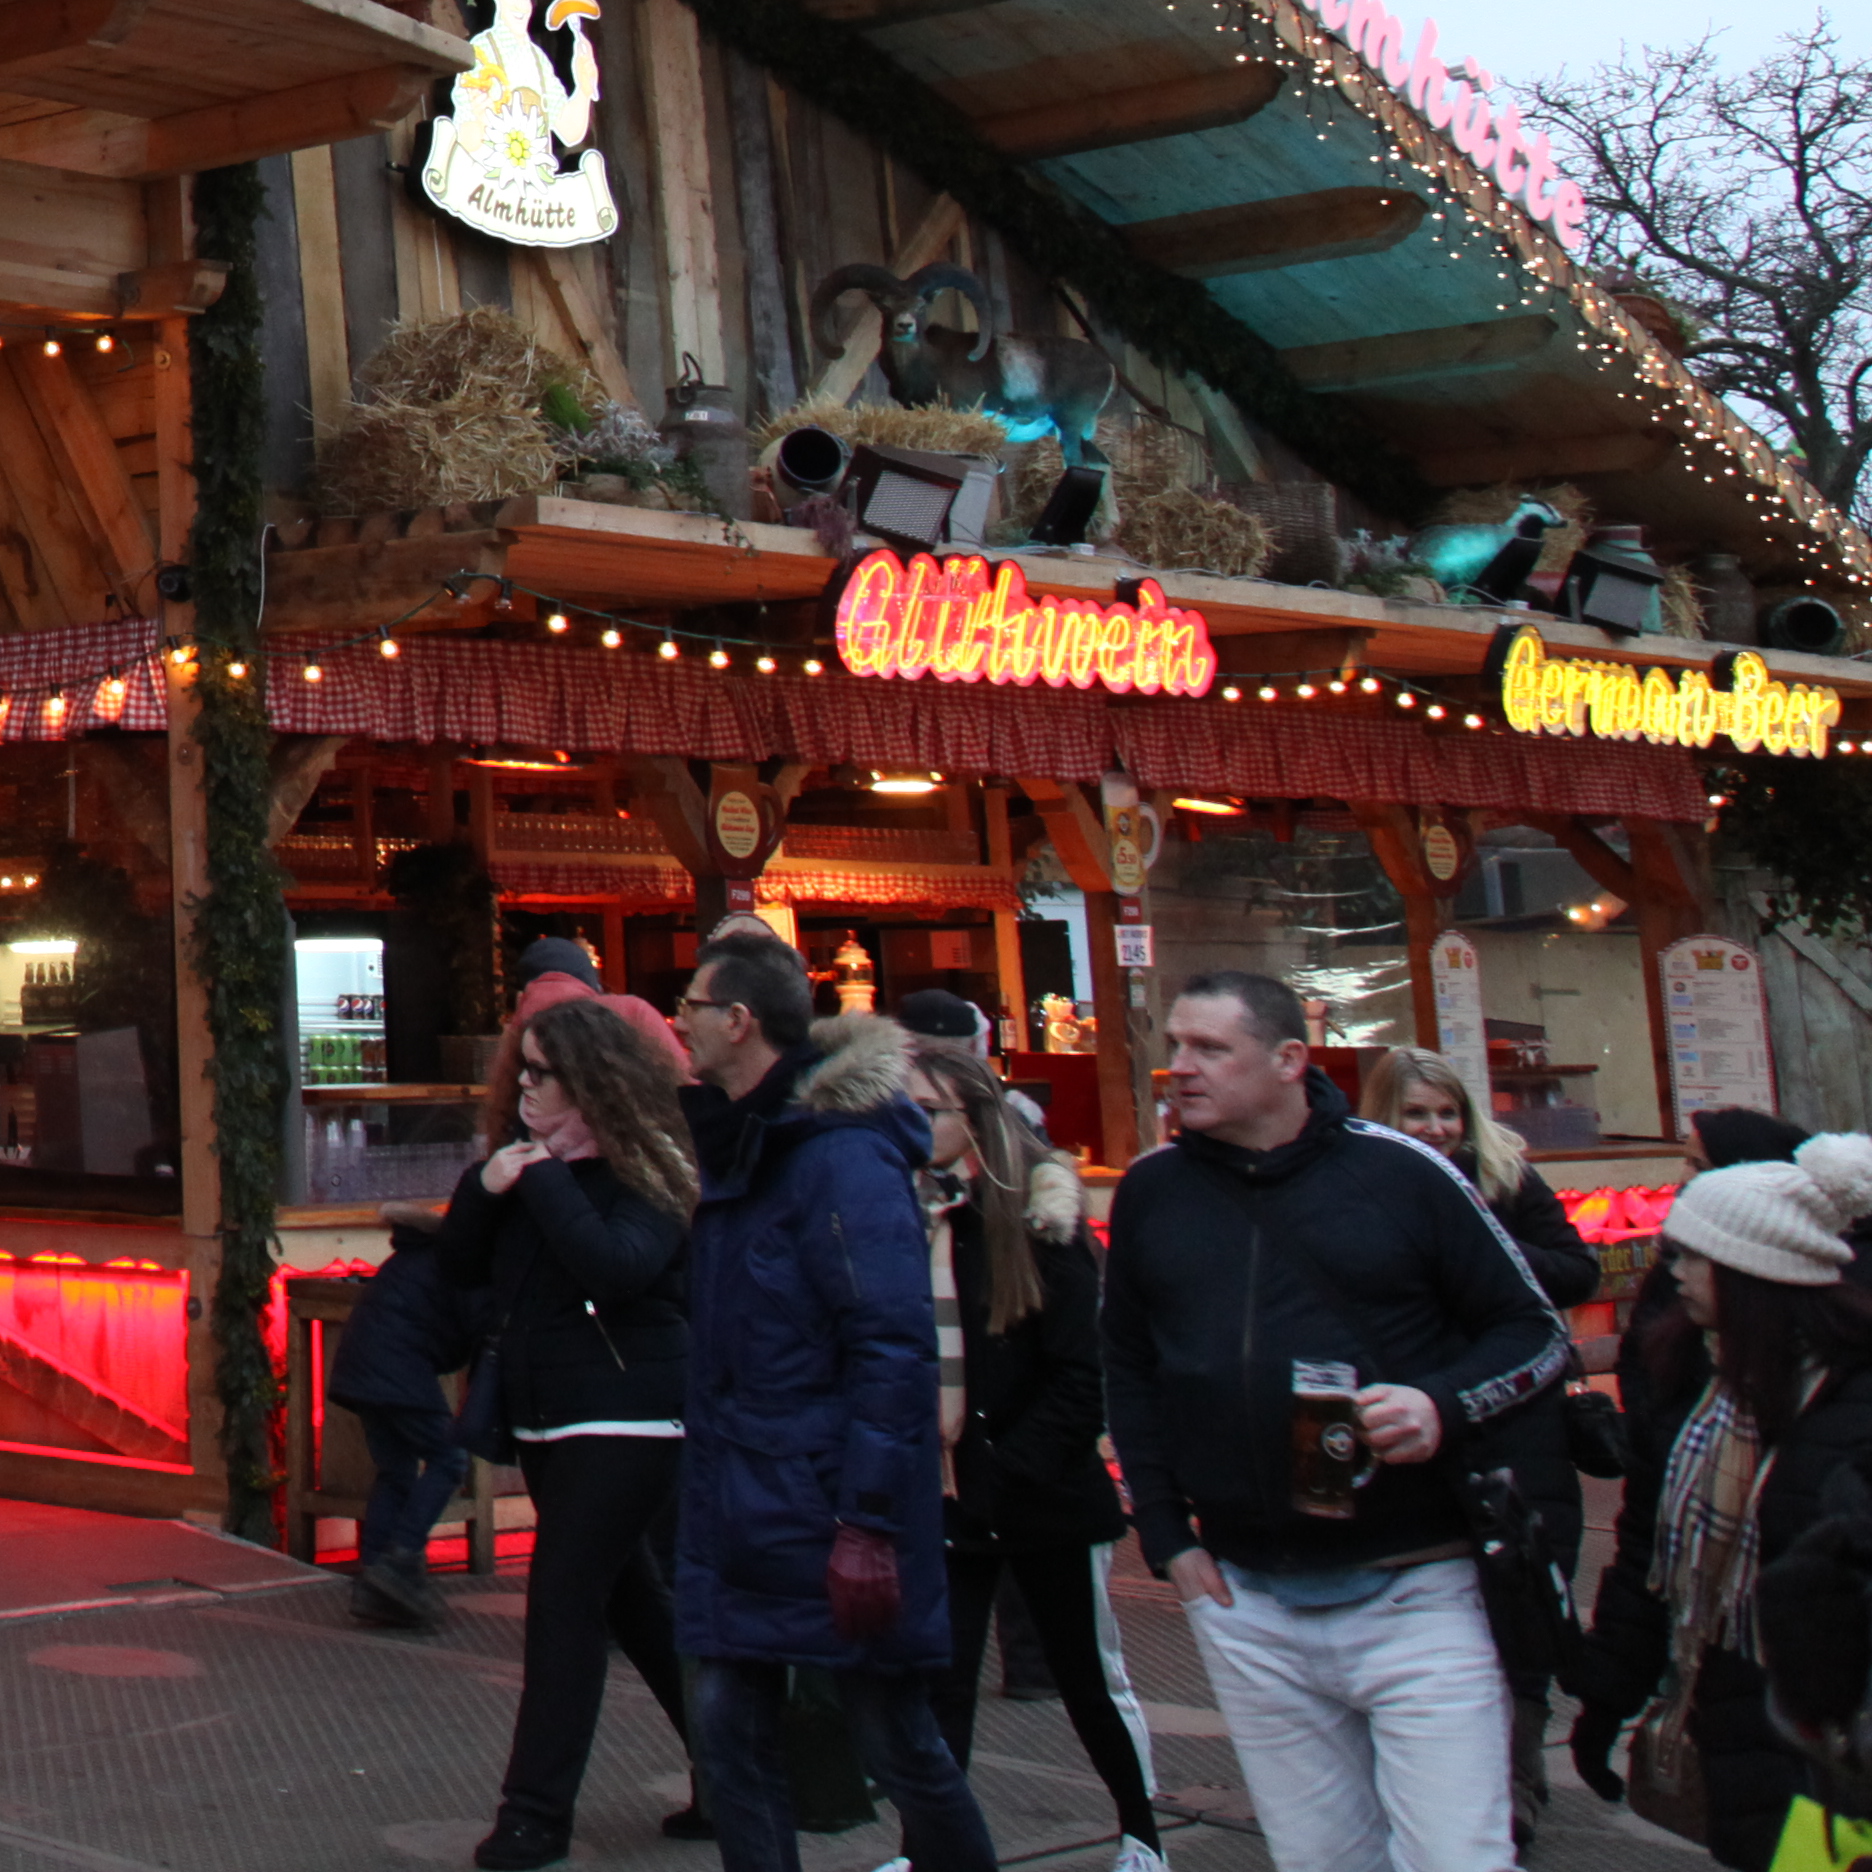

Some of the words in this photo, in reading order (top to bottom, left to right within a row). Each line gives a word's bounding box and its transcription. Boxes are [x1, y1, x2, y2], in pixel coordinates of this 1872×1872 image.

[467, 183, 577, 230] Almhütte
[838, 553, 1216, 695] Glühwein
[1502, 628, 1716, 748] German
[1733, 653, 1840, 758] Beer
